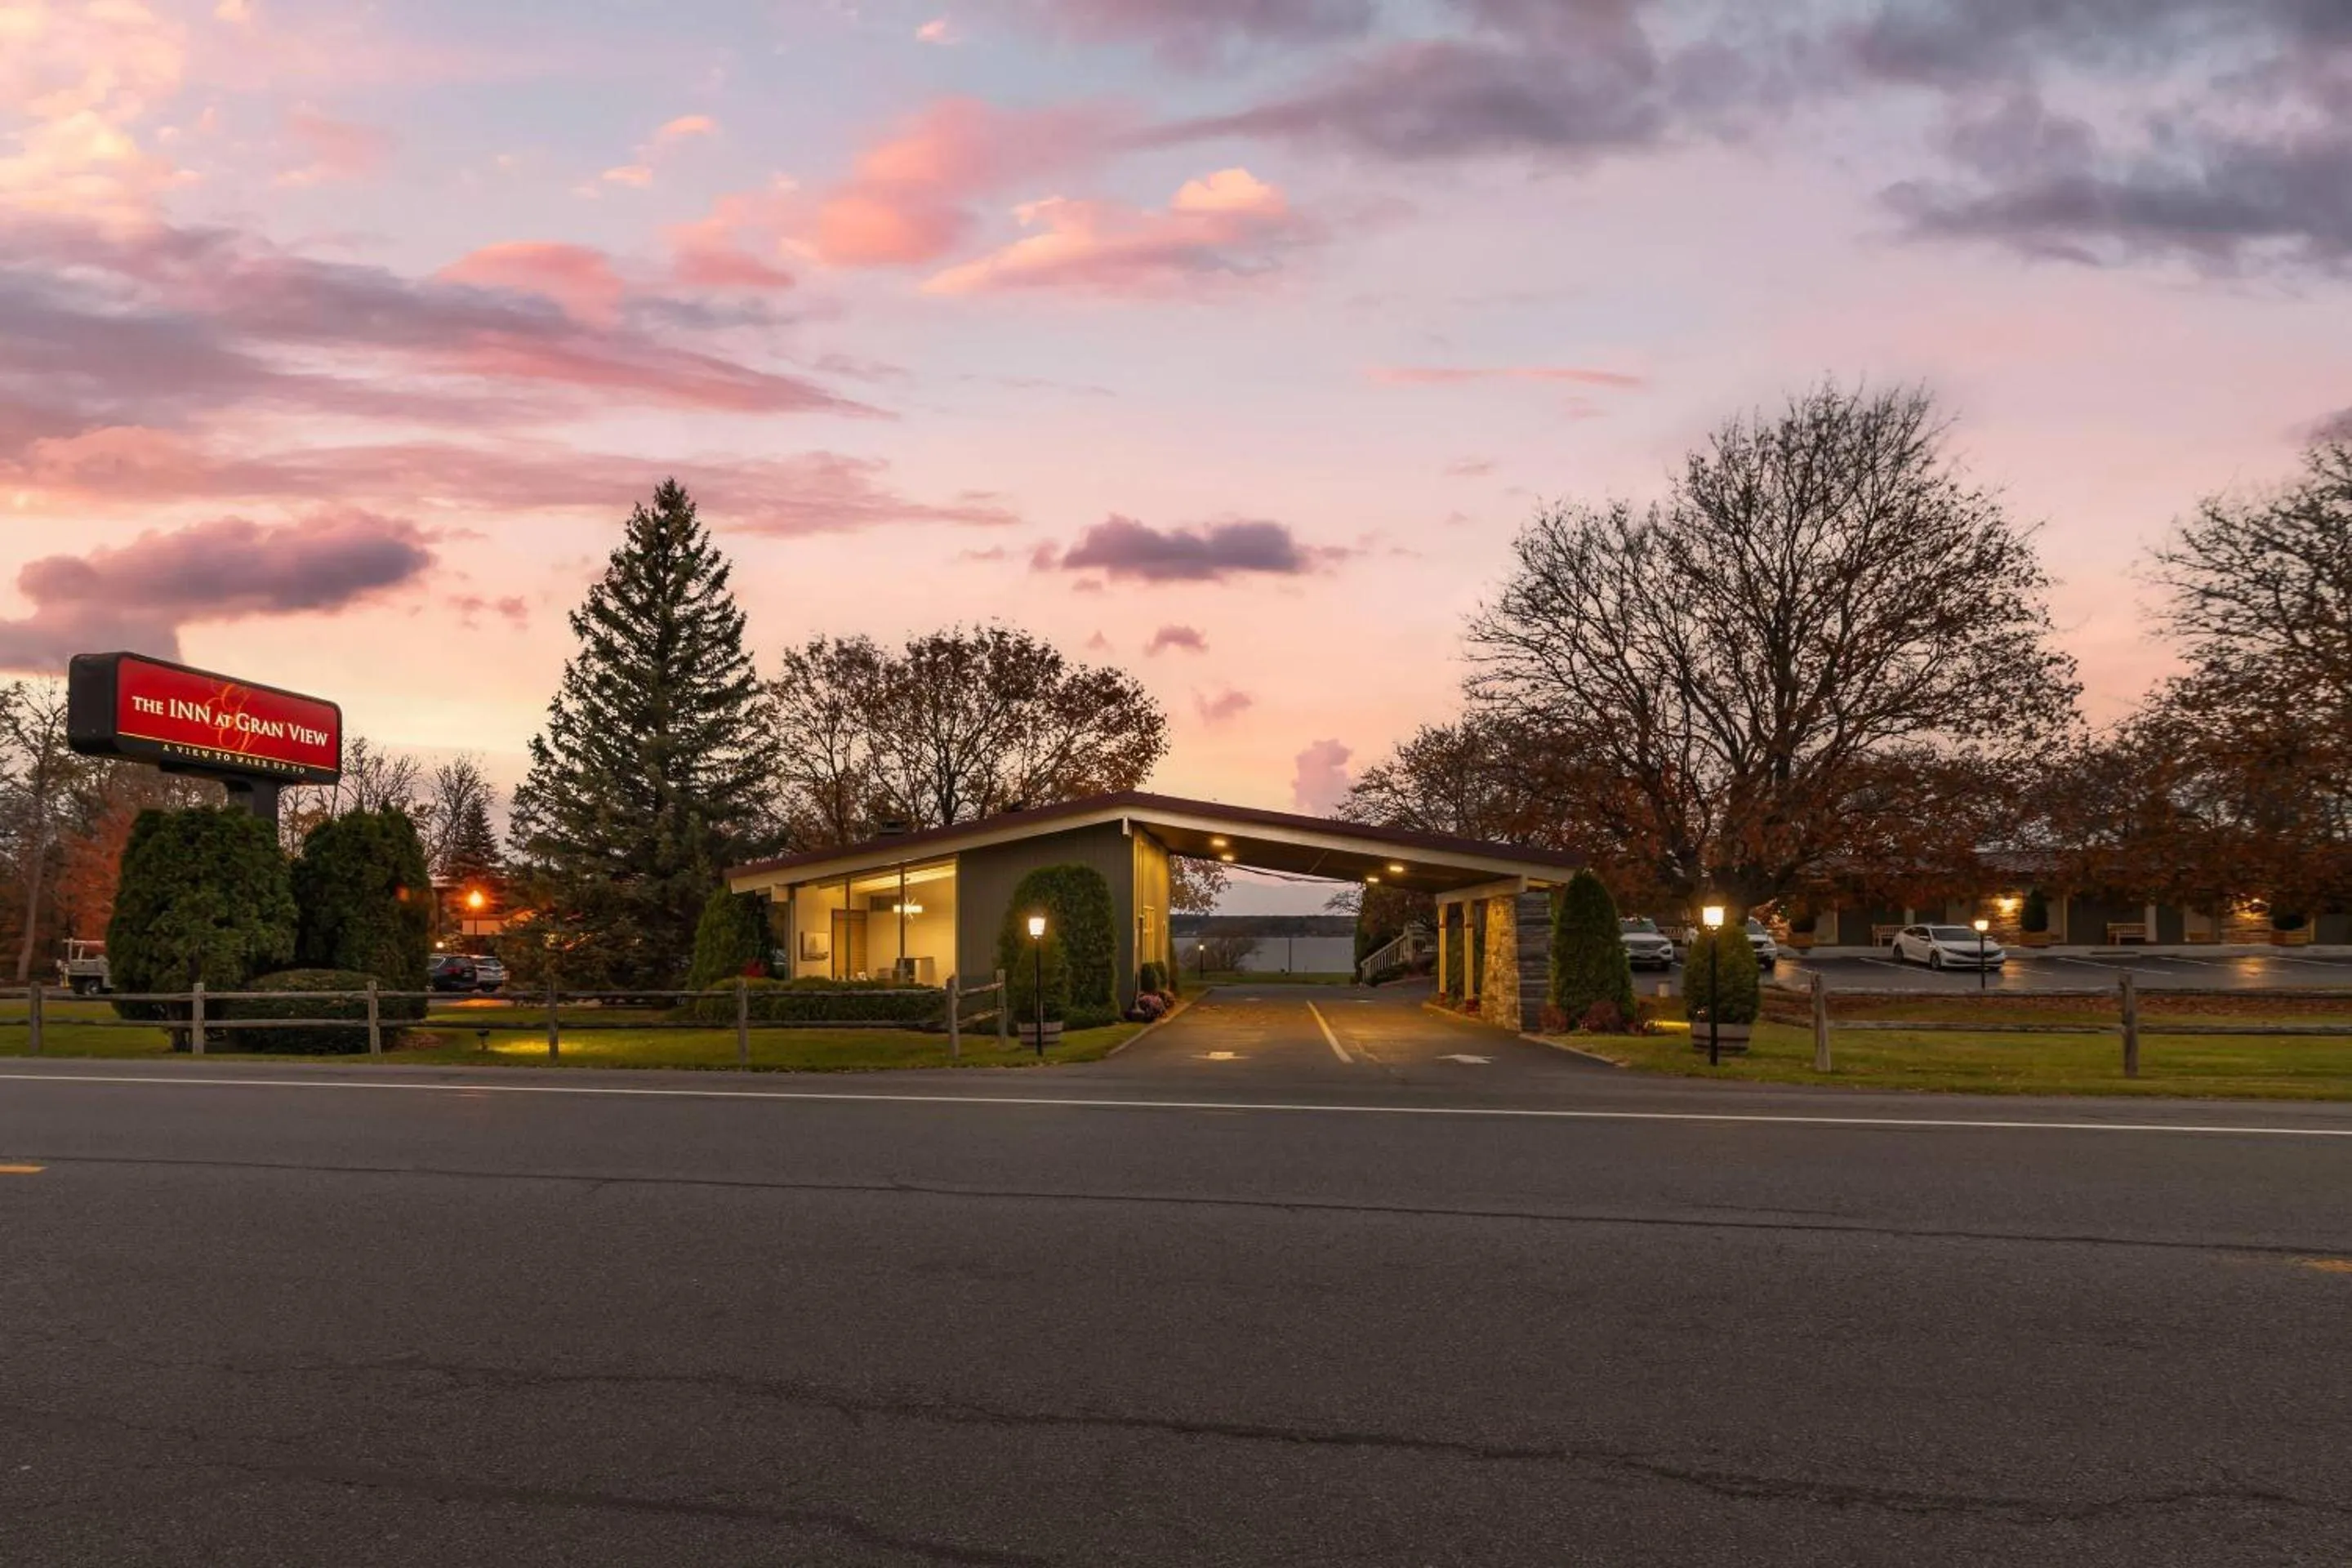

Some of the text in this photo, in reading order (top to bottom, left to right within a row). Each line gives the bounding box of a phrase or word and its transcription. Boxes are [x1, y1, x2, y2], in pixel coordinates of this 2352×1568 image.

[131, 696, 328, 746] THE INN AT GRAN VIEW
[176, 746, 209, 758] VIEW
[216, 752, 230, 761] TO
